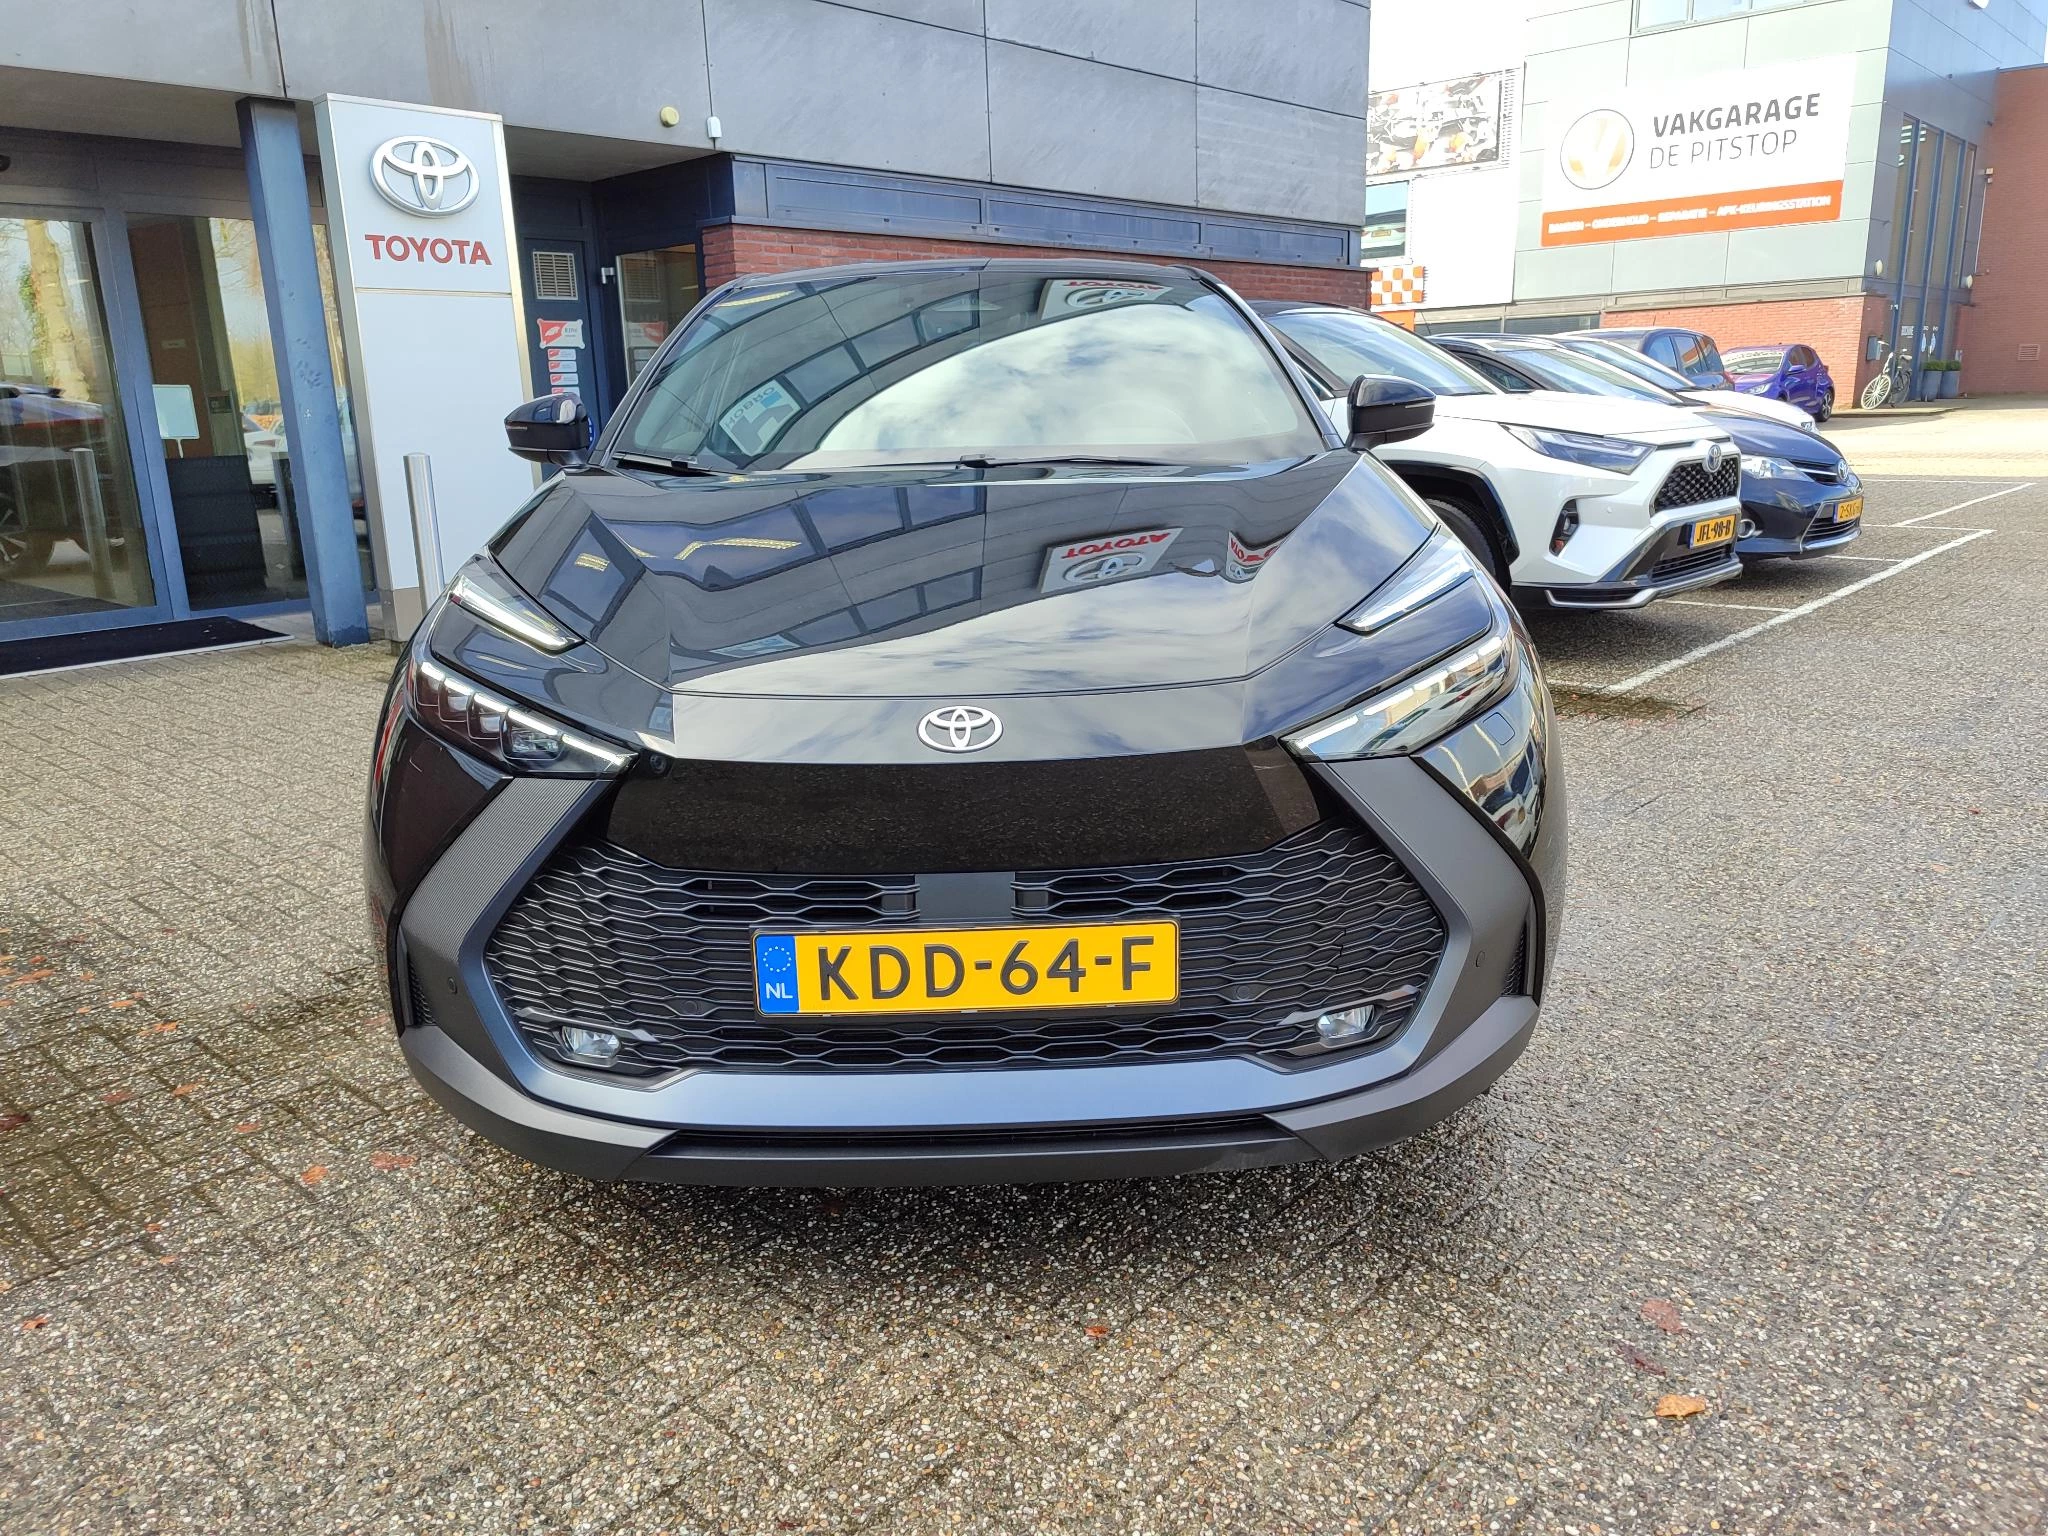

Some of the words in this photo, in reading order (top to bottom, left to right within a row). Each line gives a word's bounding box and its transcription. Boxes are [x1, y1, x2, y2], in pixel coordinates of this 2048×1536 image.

[1653, 92, 1821, 138] VAKGARAGE
[1650, 144, 1680, 170] DE
[1691, 129, 1798, 165] PITSTOP
[364, 234, 493, 266] TOYOTA
[766, 982, 794, 1000] NL
[817, 935, 1156, 1001] KDD-64-F
